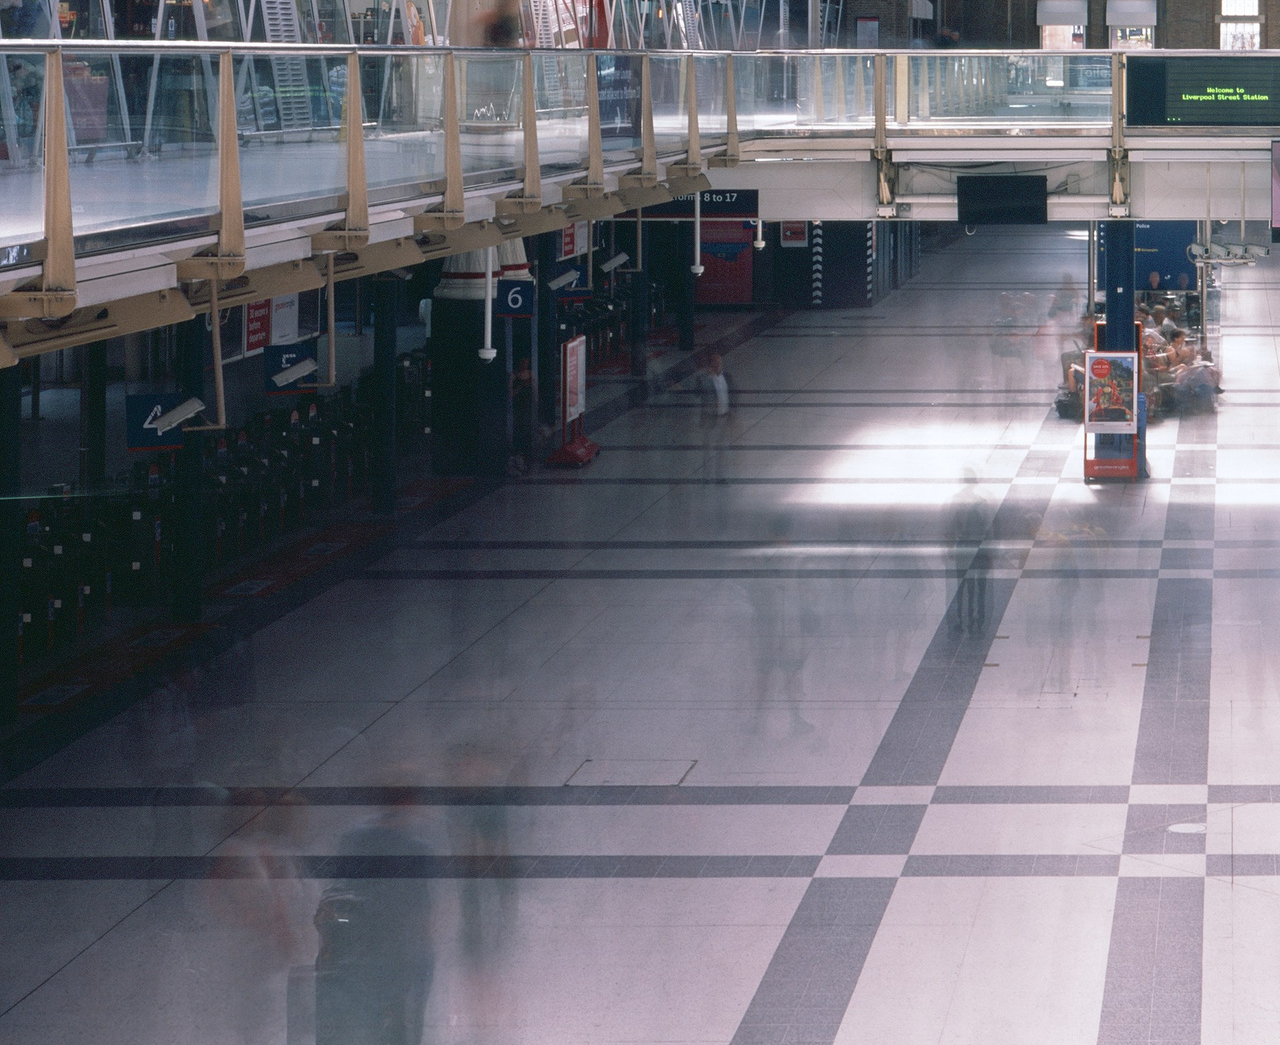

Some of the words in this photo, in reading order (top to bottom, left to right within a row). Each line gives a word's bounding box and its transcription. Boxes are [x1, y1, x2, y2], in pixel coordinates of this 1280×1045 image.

[704, 193, 711, 201] 8
[725, 193, 738, 201] 17
[507, 287, 522, 308] 6
